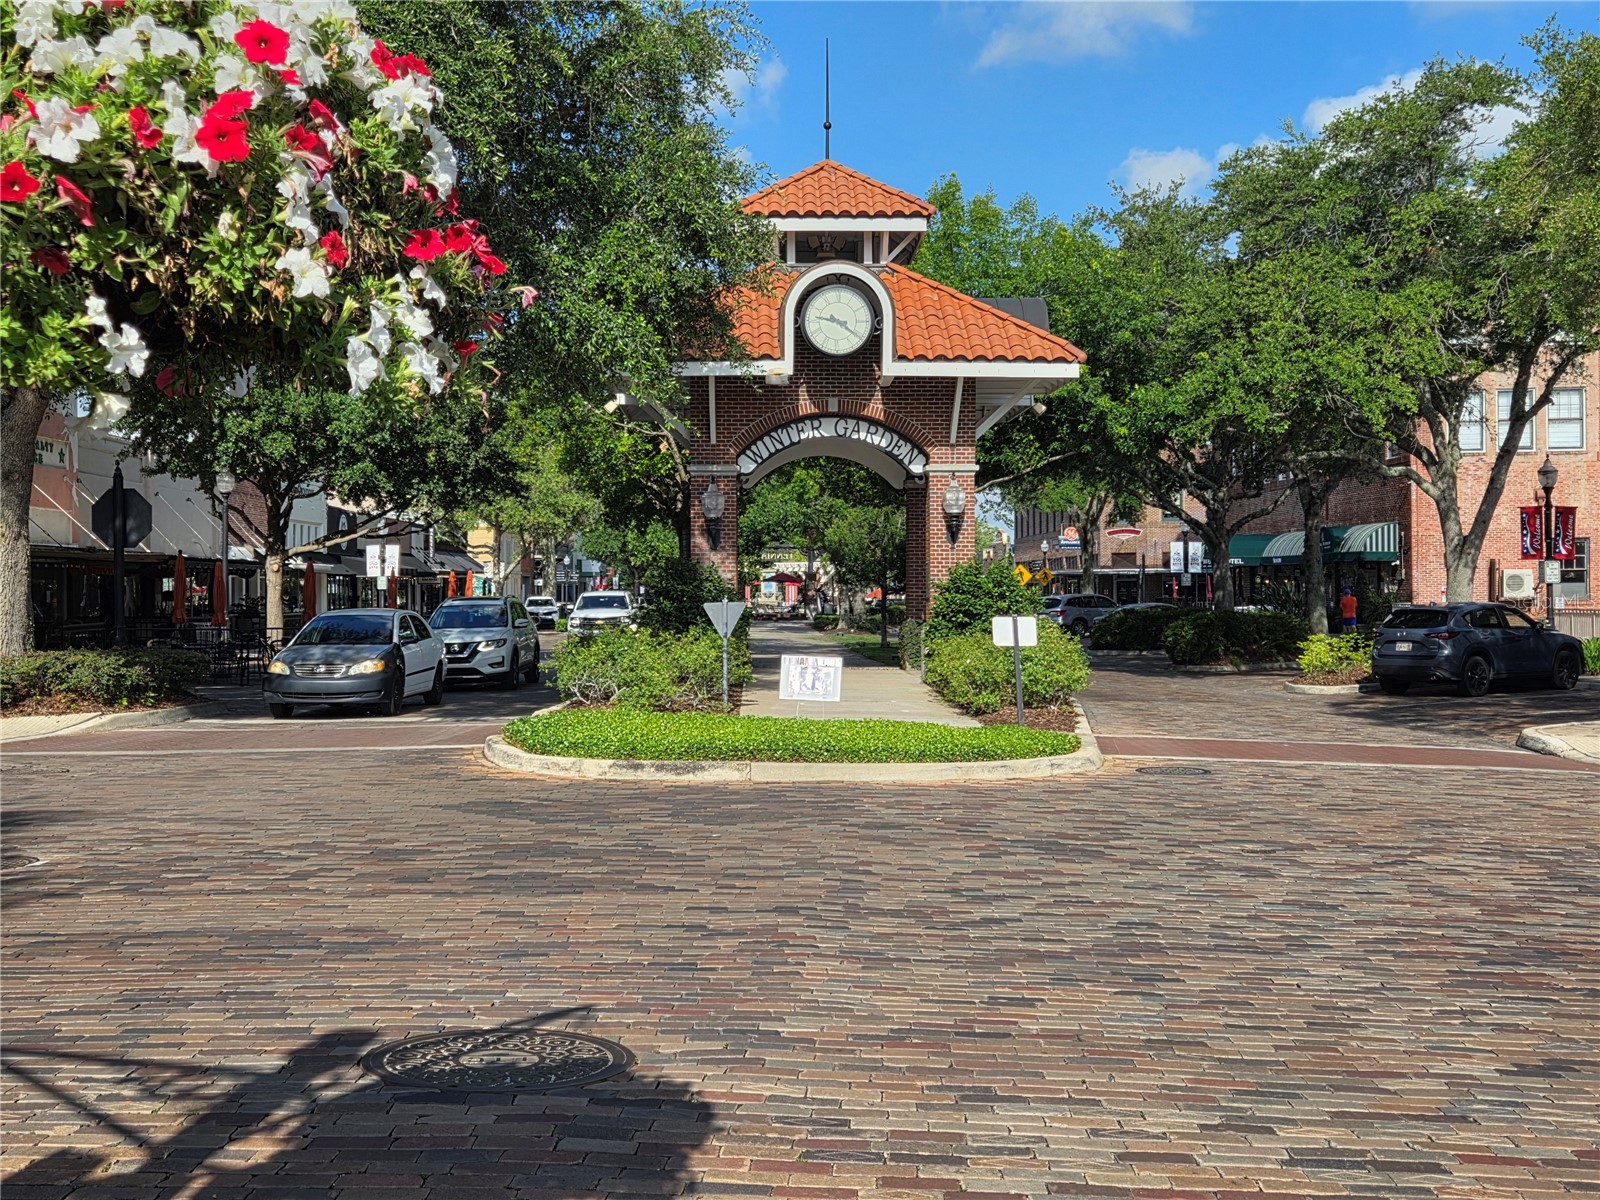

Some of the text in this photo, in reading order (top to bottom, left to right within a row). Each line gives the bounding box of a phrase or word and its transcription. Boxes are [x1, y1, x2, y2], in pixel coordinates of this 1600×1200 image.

[743, 417, 921, 467] WINTER GARDEN
[1533, 514, 1541, 549] Welcome
[1564, 514, 1574, 549] Welcome
